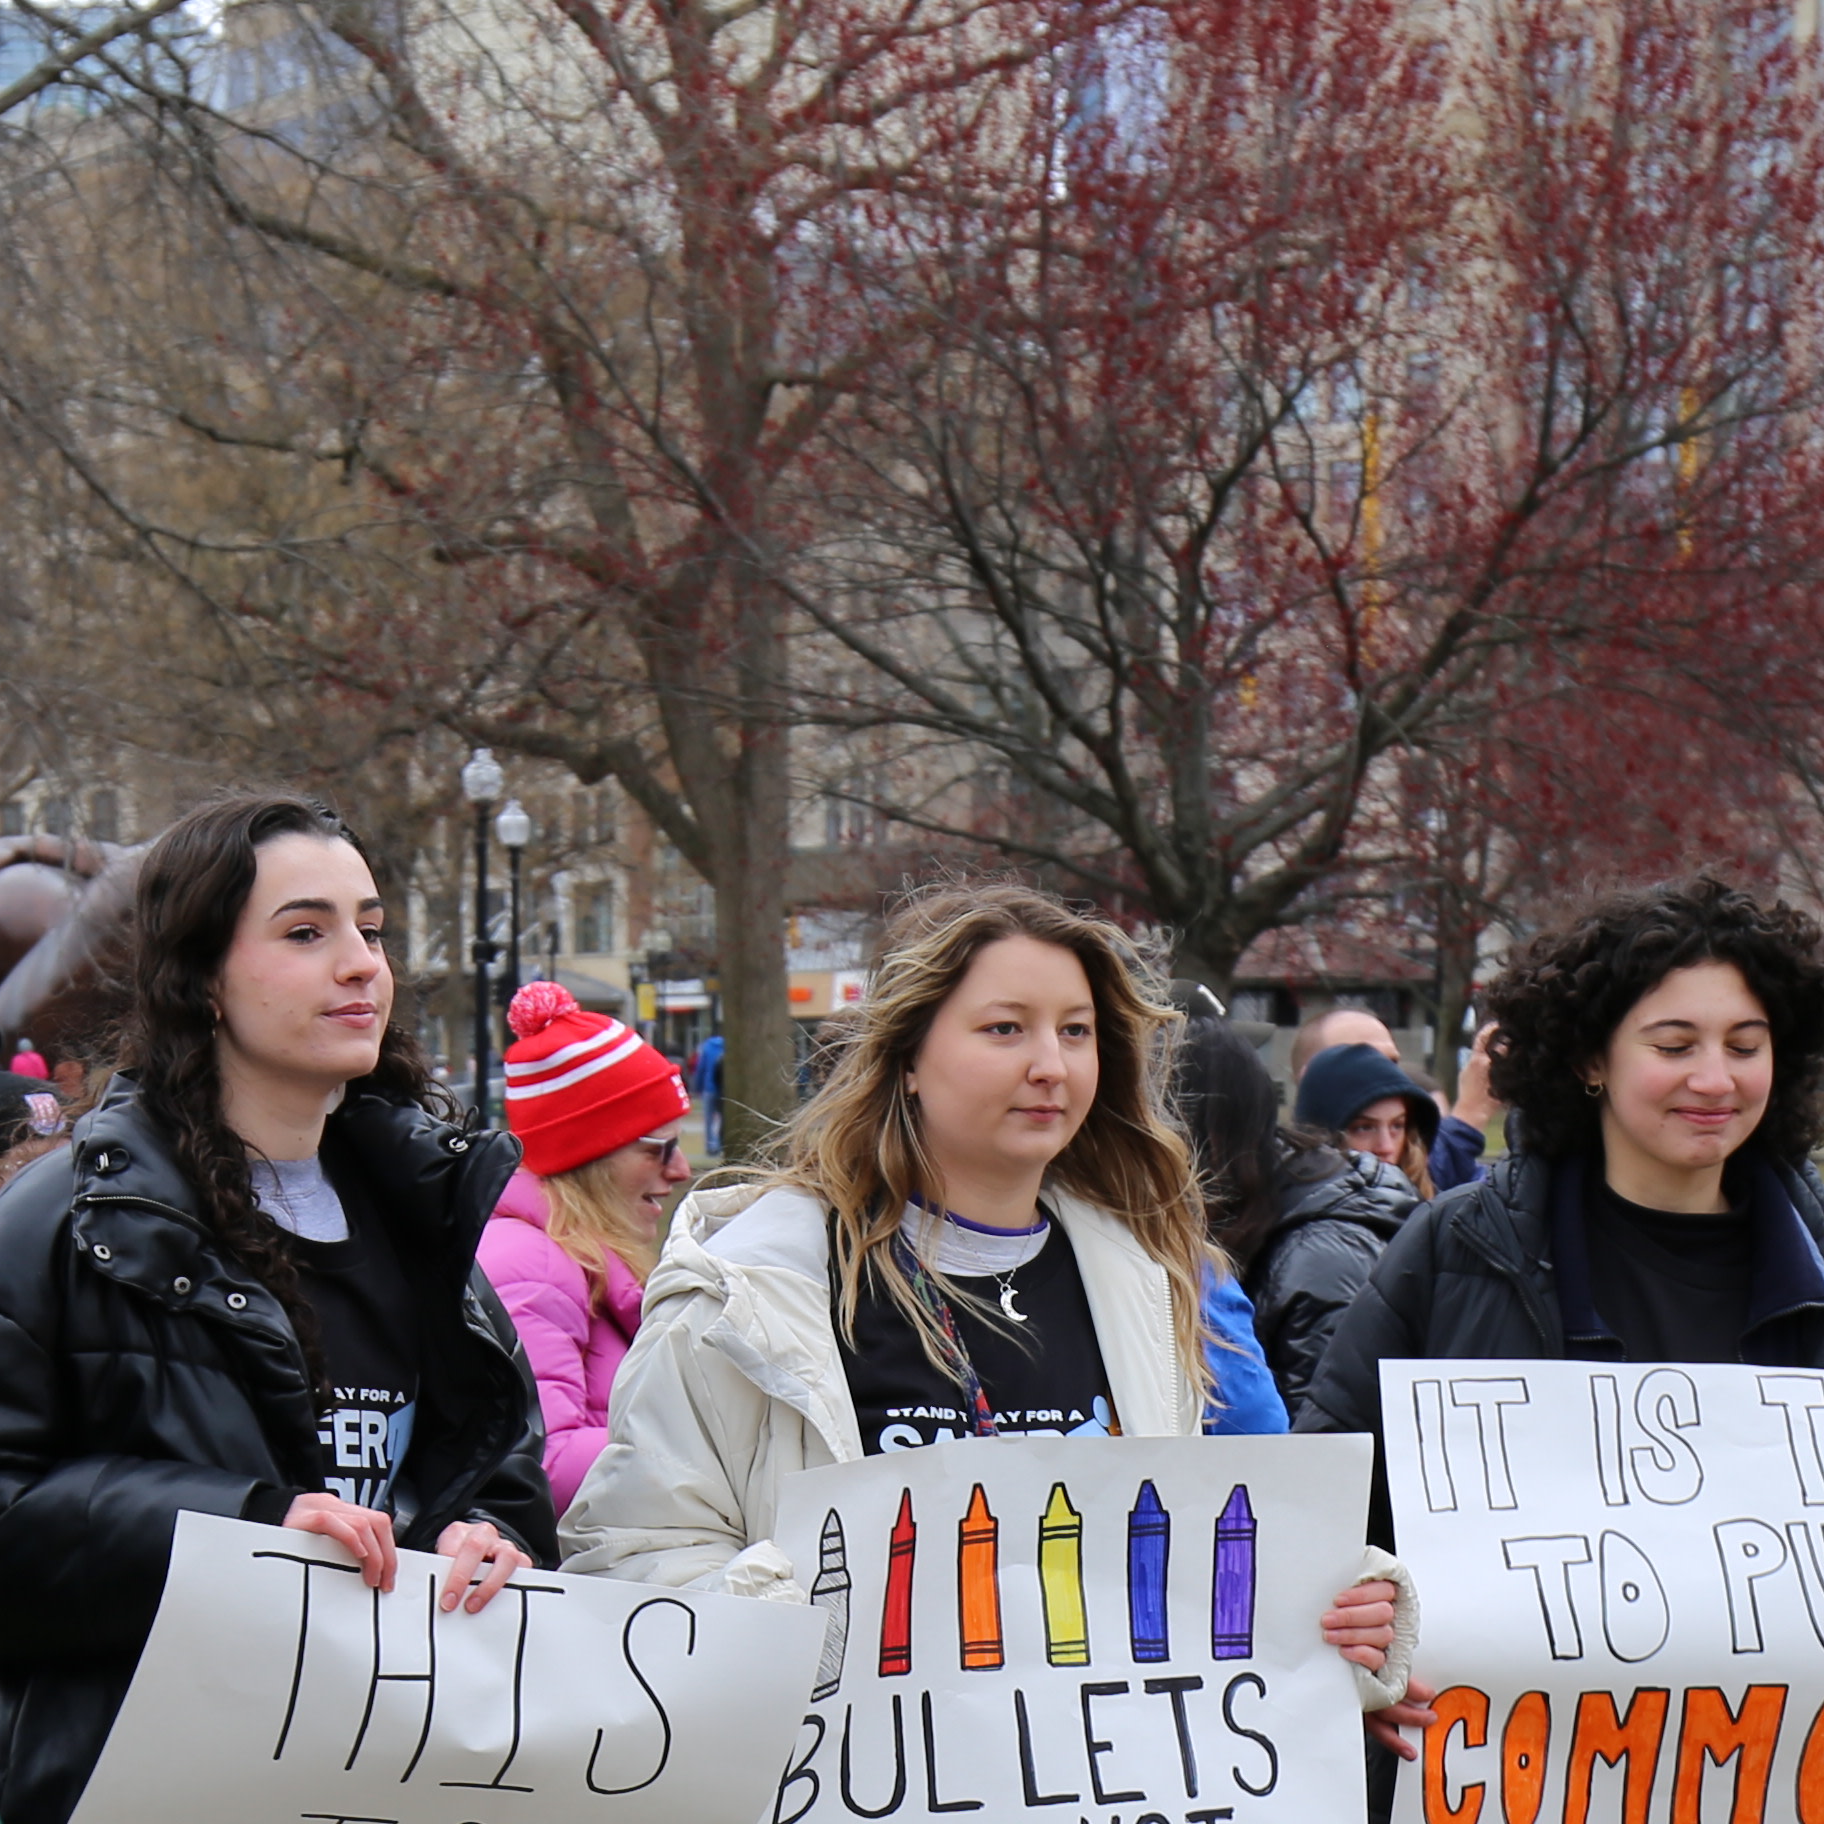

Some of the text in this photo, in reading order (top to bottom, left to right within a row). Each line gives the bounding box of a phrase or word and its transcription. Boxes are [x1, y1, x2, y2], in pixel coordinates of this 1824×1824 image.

[360, 1388, 390, 1402] FOR
[394, 1391, 406, 1403] A
[1026, 1410, 1064, 1423] FOR
[1068, 1409, 1085, 1422] A
[1412, 1376, 1530, 1513] IT
[1589, 1369, 1704, 1507] IS
[1501, 1528, 1671, 1663] TO
[253, 1550, 698, 1795] THIS
